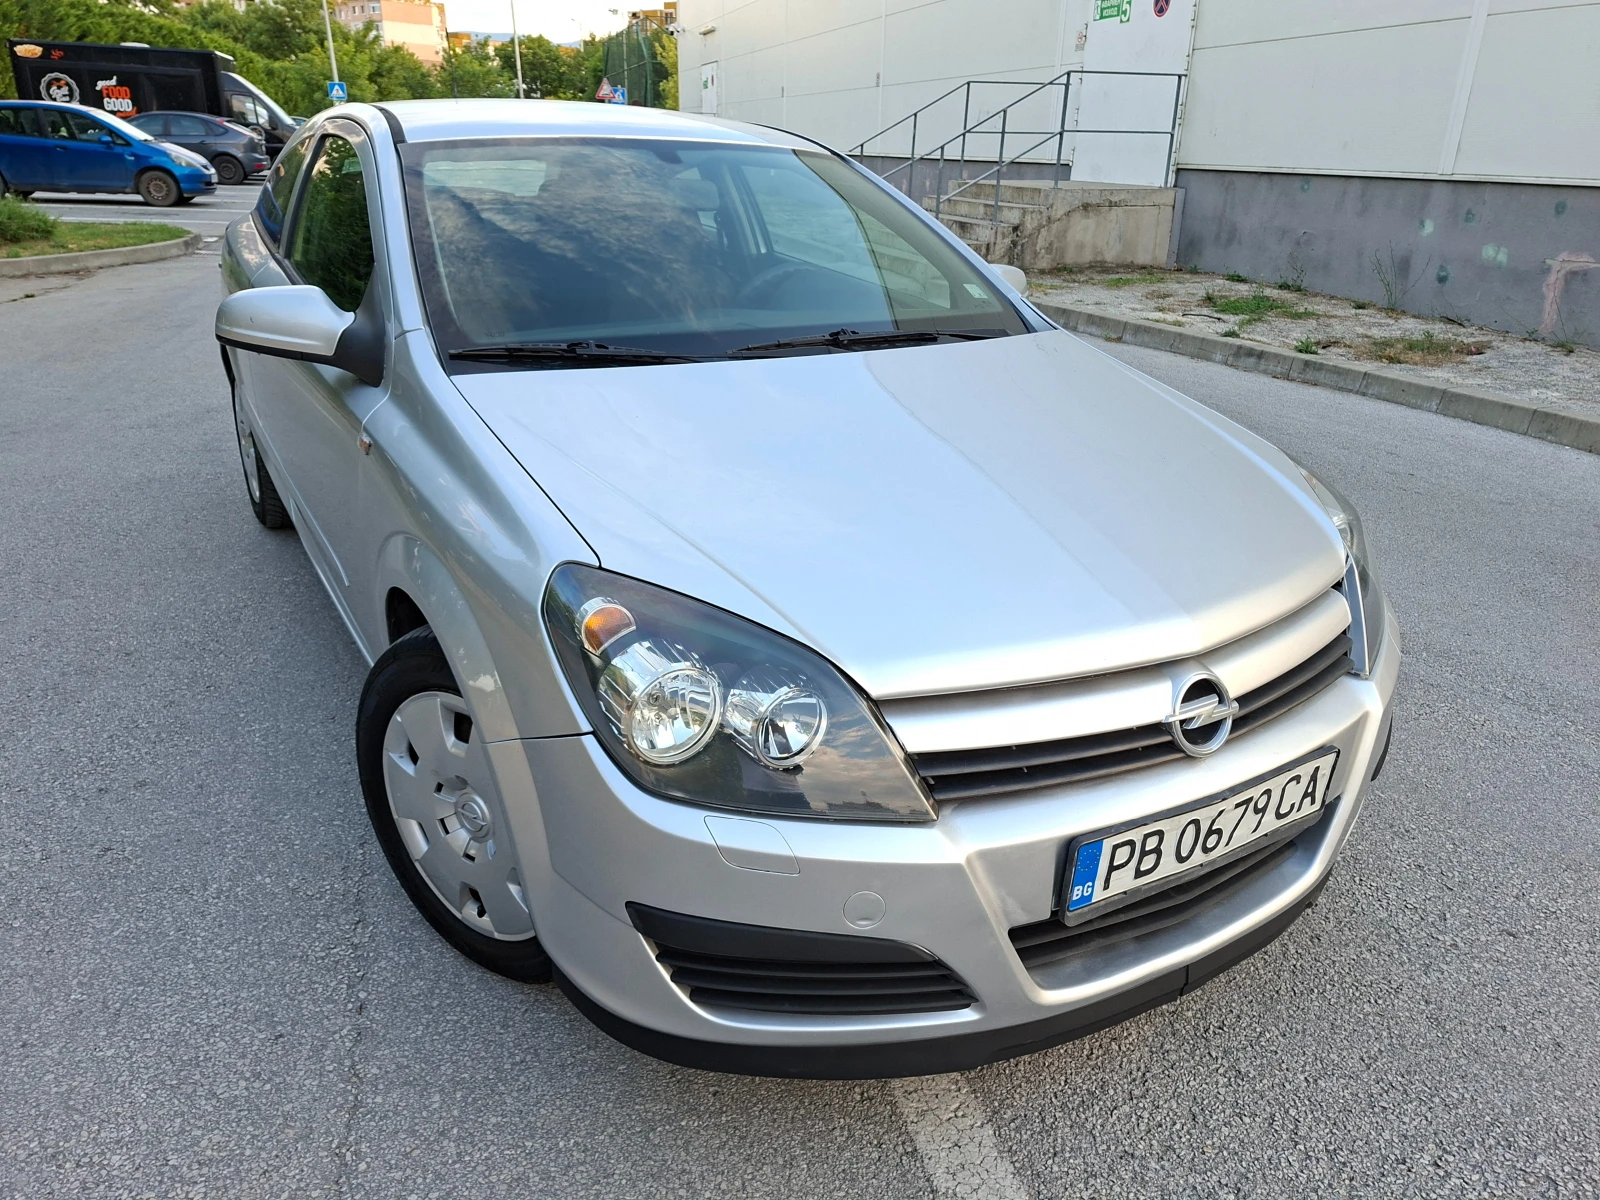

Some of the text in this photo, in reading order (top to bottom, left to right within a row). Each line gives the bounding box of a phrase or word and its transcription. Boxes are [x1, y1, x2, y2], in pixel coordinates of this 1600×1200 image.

[1121, 0, 1131, 22] 5
[102, 86, 130, 98] FOOD
[103, 98, 132, 111] GOOD
[1102, 765, 1321, 891] PB 0679 CA
[1072, 881, 1093, 901] BG
